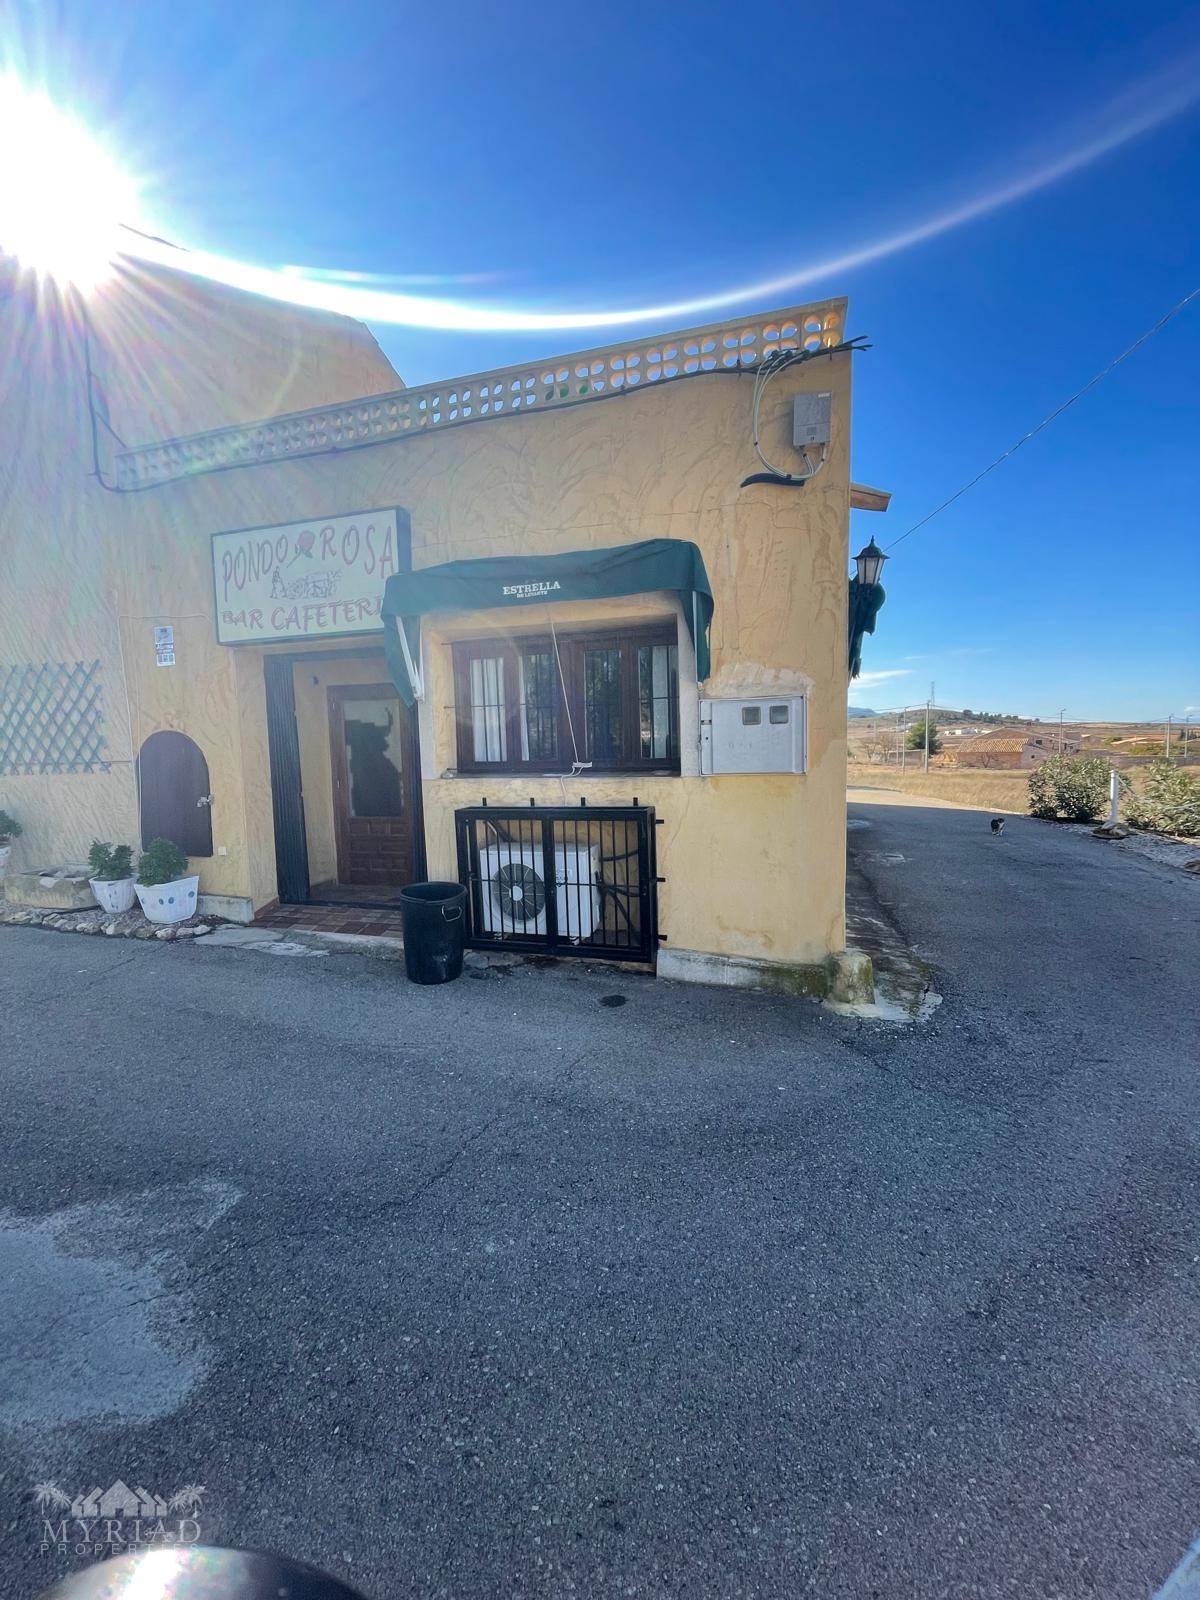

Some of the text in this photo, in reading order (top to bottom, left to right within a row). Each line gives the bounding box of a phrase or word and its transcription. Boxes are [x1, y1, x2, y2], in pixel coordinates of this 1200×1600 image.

[222, 524, 394, 602] PONDO ROSA
[502, 581, 560, 595] ESTRELLA
[221, 593, 382, 632] BAR CAFETERI
